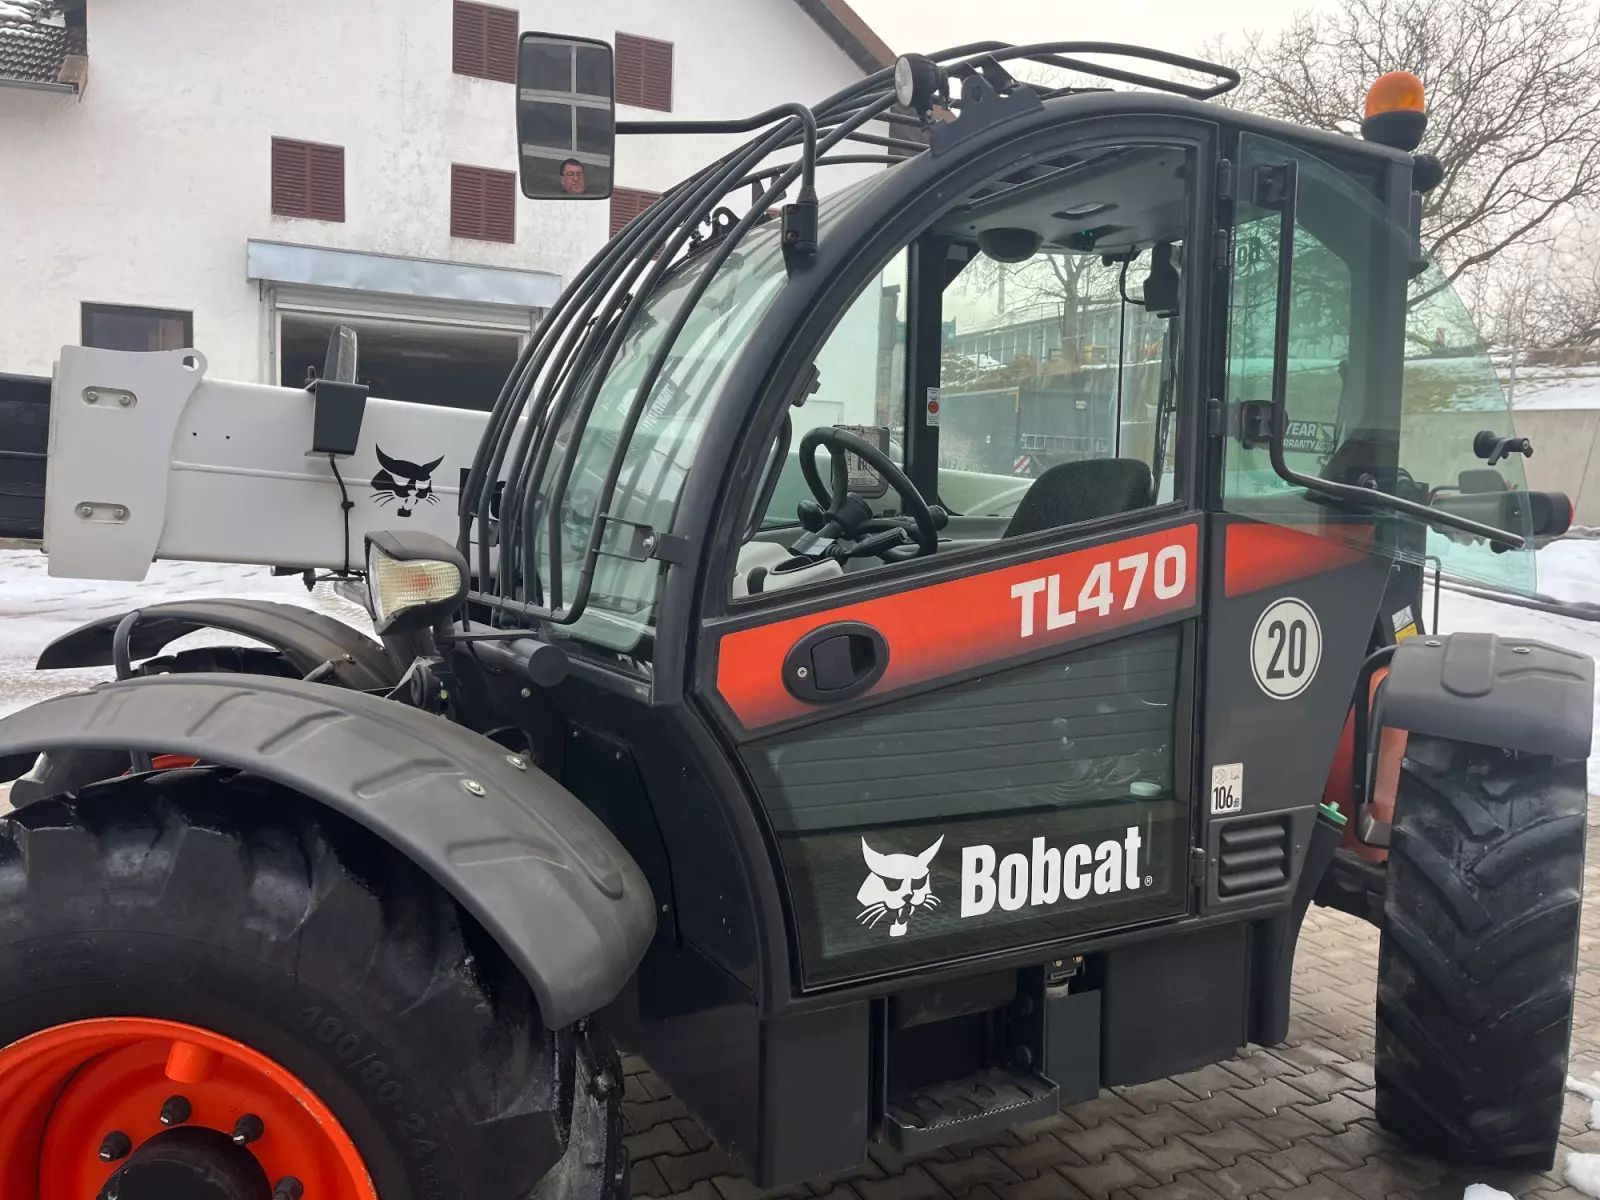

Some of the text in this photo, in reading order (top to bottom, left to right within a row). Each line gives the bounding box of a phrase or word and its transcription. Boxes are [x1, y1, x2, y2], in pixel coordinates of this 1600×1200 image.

[1283, 438, 1316, 449] RRANTY
[1010, 544, 1187, 638] TL470
[1266, 619, 1307, 680] 20
[1213, 785, 1233, 810] 106
[960, 826, 1141, 918] Bobcat
